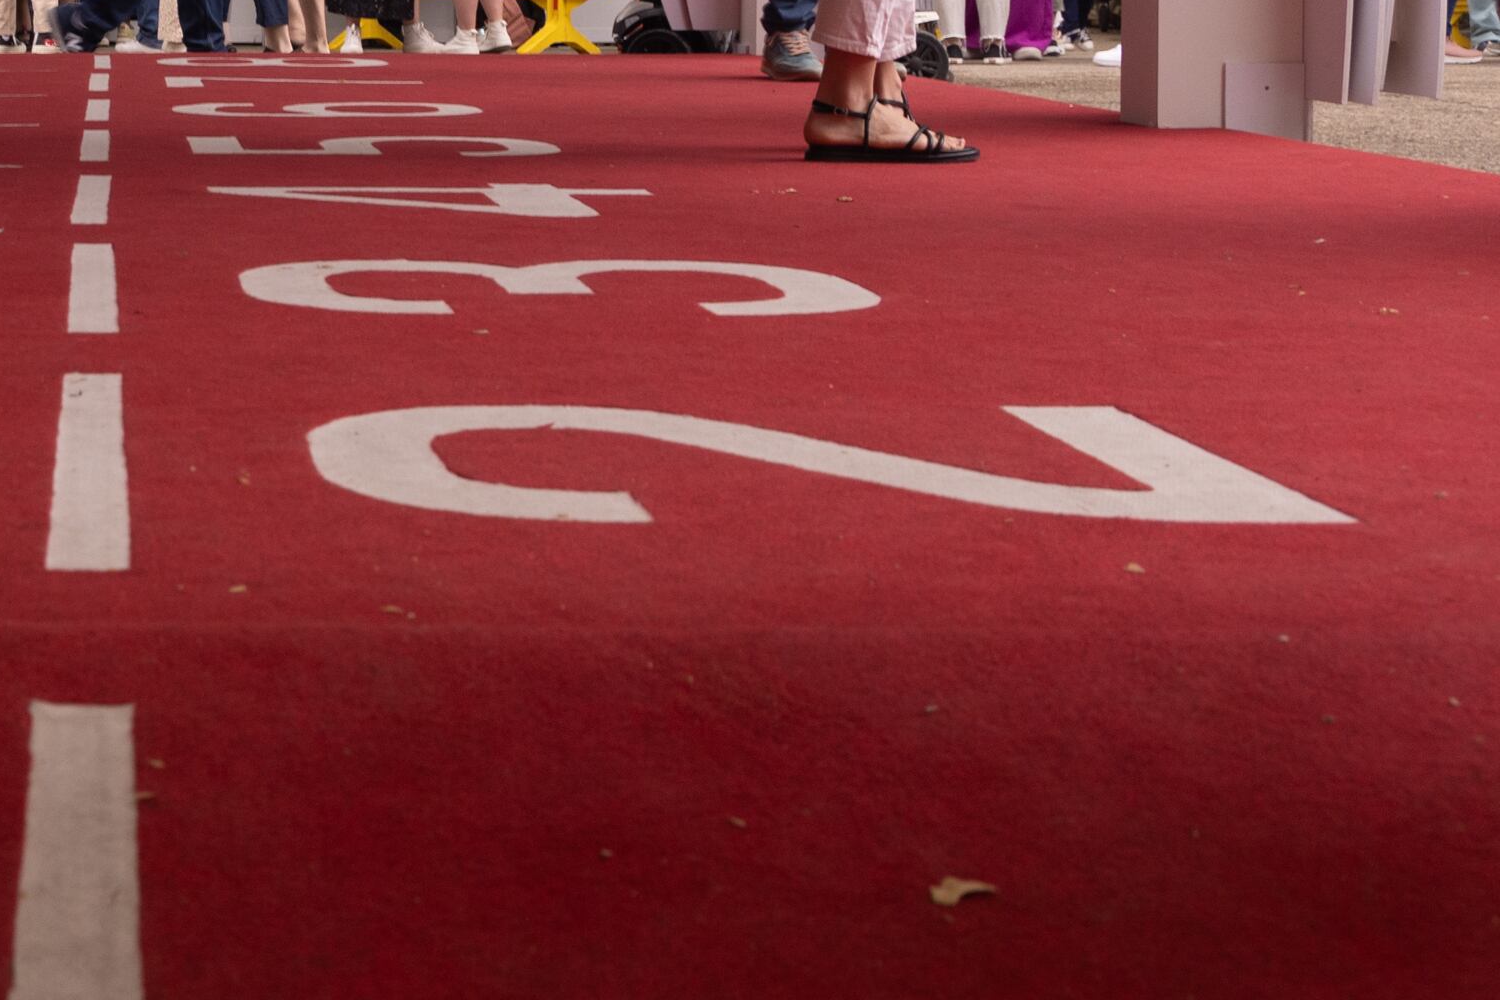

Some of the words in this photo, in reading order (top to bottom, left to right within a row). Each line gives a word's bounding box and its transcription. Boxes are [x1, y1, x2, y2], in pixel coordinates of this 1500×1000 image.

[172, 102, 482, 117] 6
[186, 136, 561, 157] 5
[207, 183, 654, 218] 4
[238, 258, 881, 316] 3
[305, 404, 1357, 525] 2
